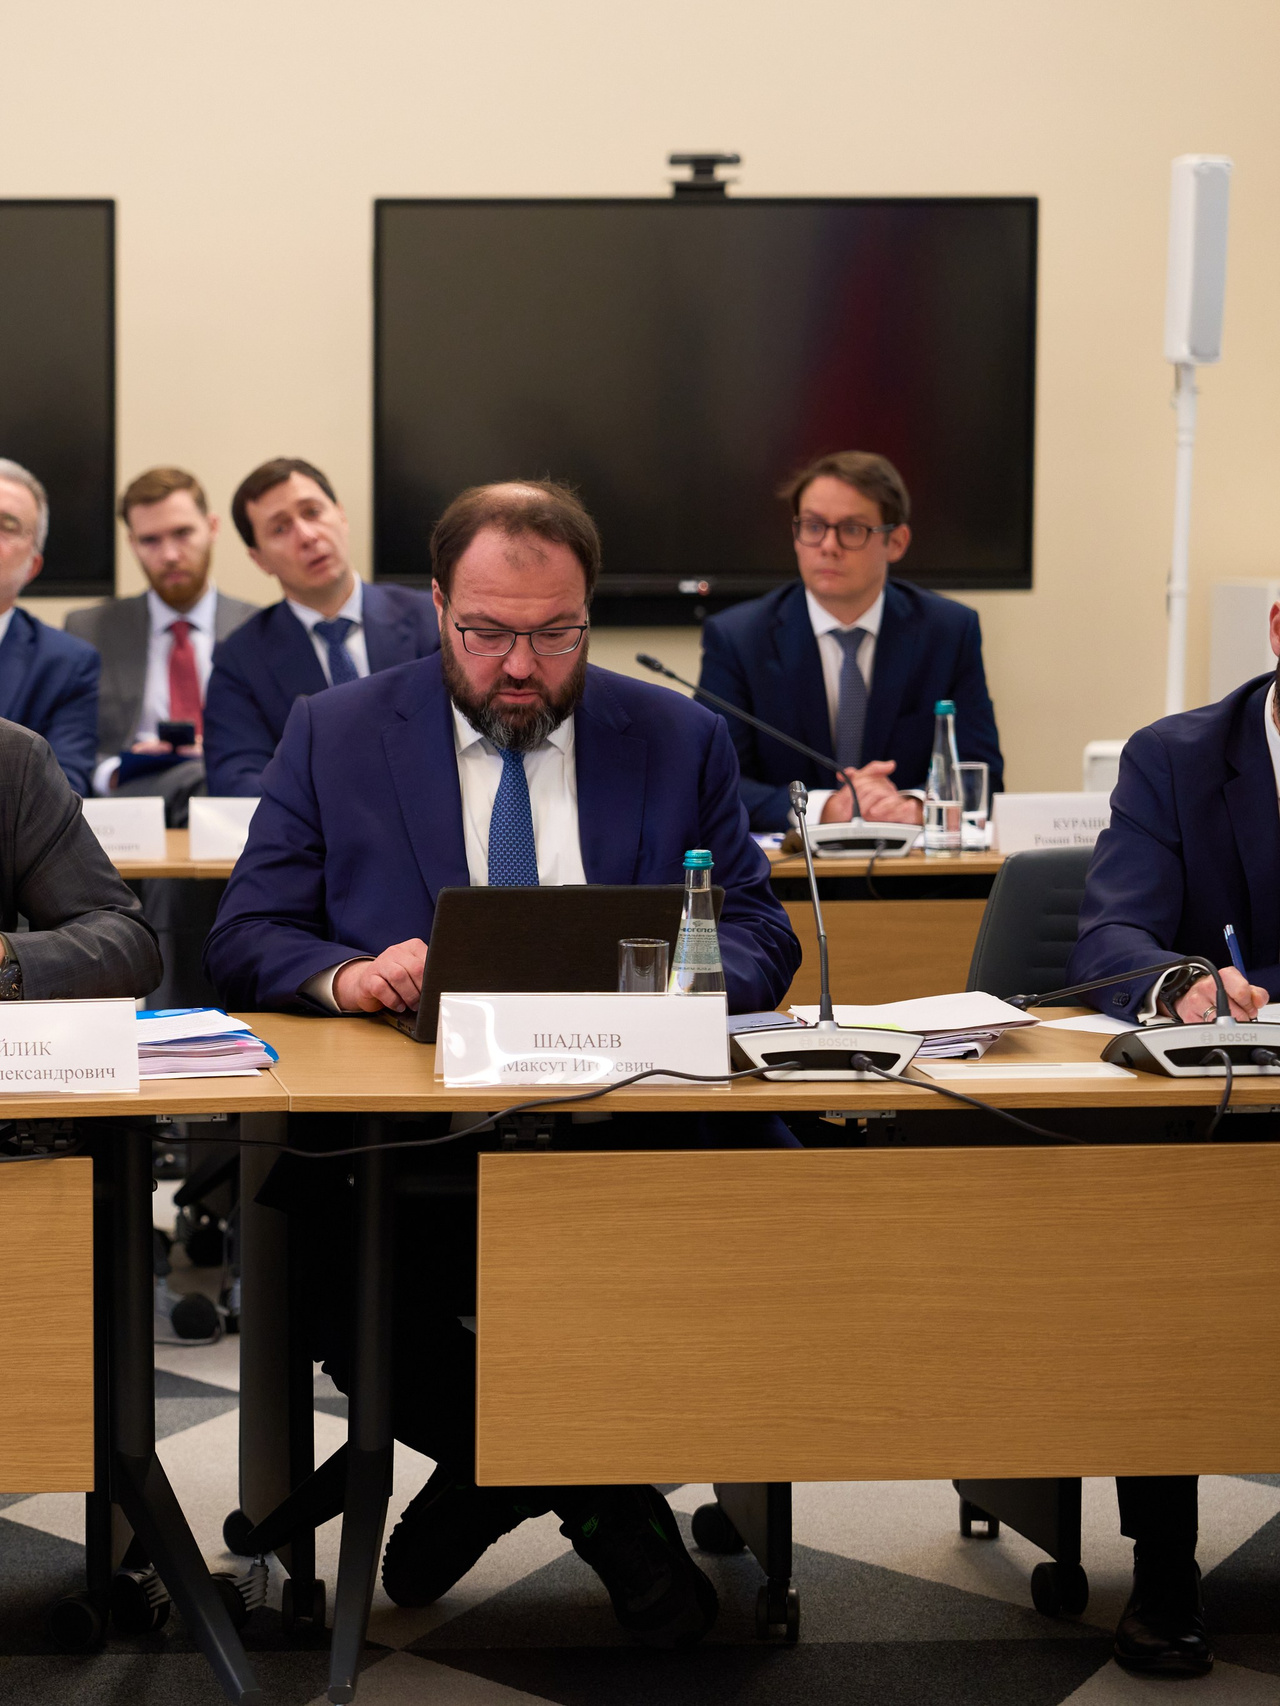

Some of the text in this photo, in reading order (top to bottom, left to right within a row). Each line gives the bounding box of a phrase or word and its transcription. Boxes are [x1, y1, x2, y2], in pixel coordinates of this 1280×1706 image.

[533, 1033, 622, 1050] ШАДАЕВ
[818, 1038, 858, 1047] BOSCH
[1219, 1033, 1258, 1042] BOSCH
[503, 1058, 654, 1076] Максут Игевич
[581, 1516, 597, 1532] NIKE
